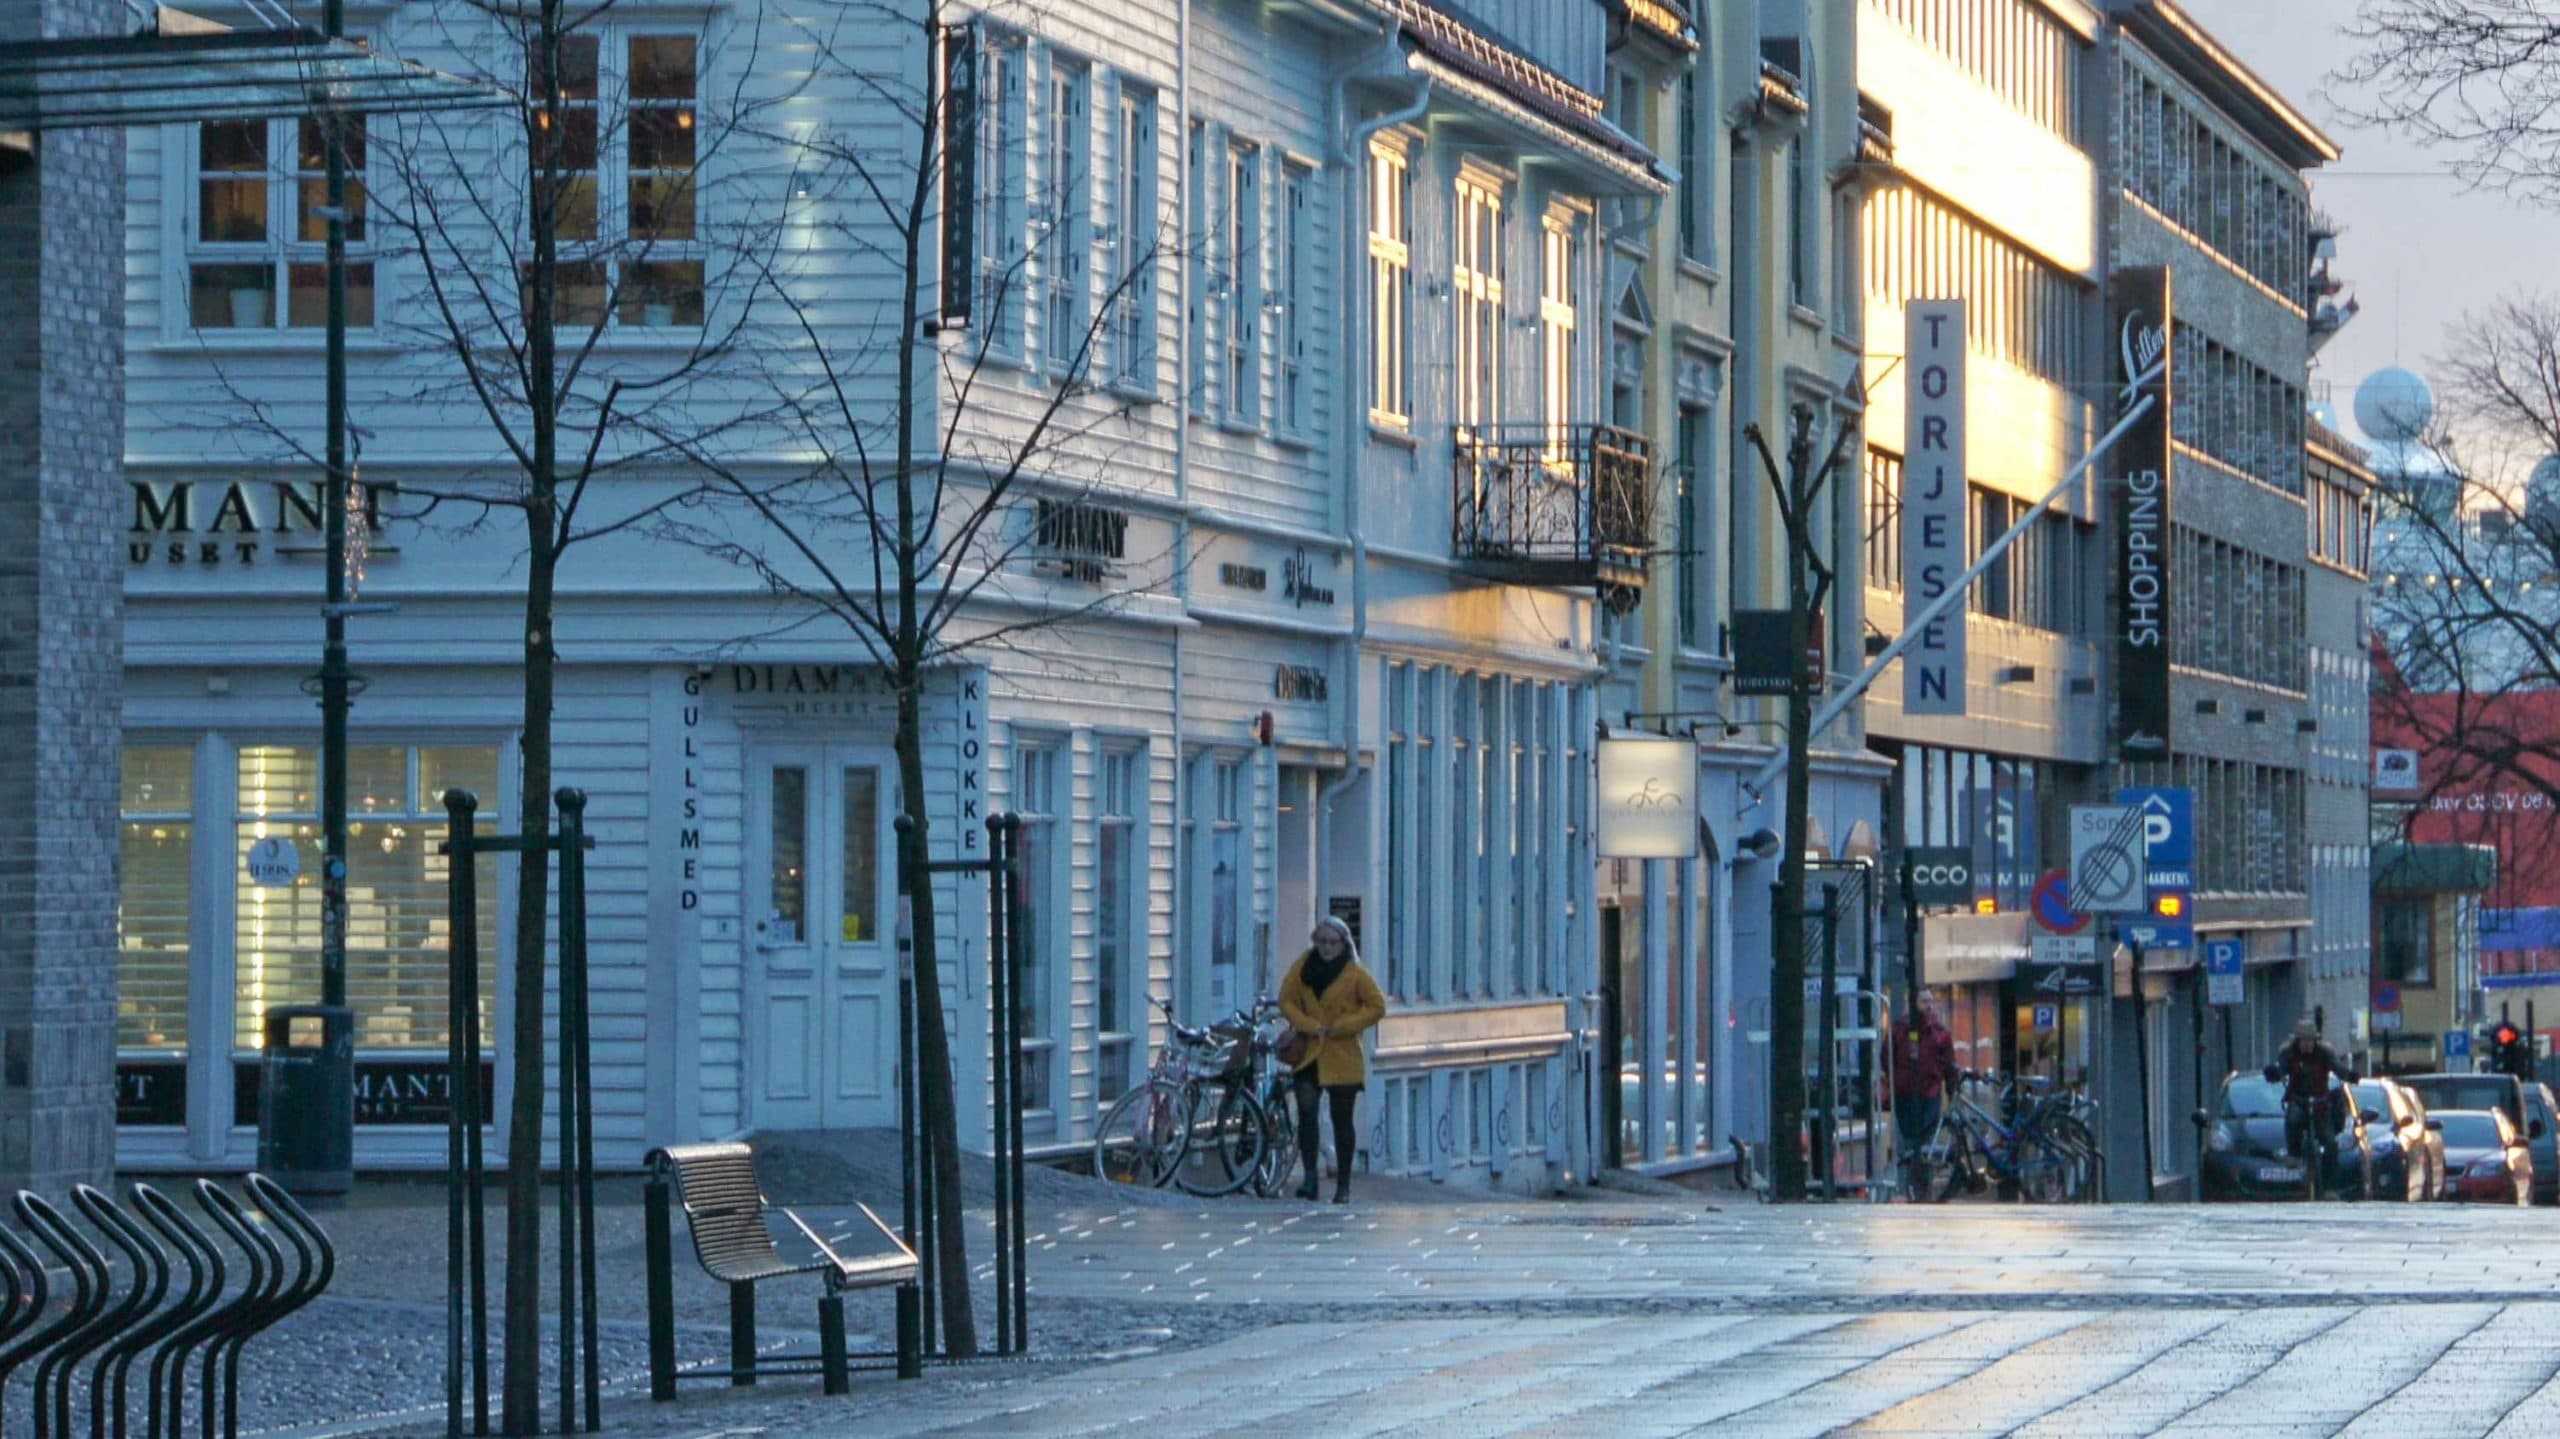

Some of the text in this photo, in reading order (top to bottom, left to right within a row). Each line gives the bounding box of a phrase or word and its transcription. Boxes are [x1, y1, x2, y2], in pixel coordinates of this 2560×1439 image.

[128, 542, 258, 564] USET
[1921, 314, 1948, 701] TORJESEN
[2128, 469, 2160, 647] SHOPPING
[680, 675, 699, 910] GULLSMED
[2144, 814, 2171, 857] P
